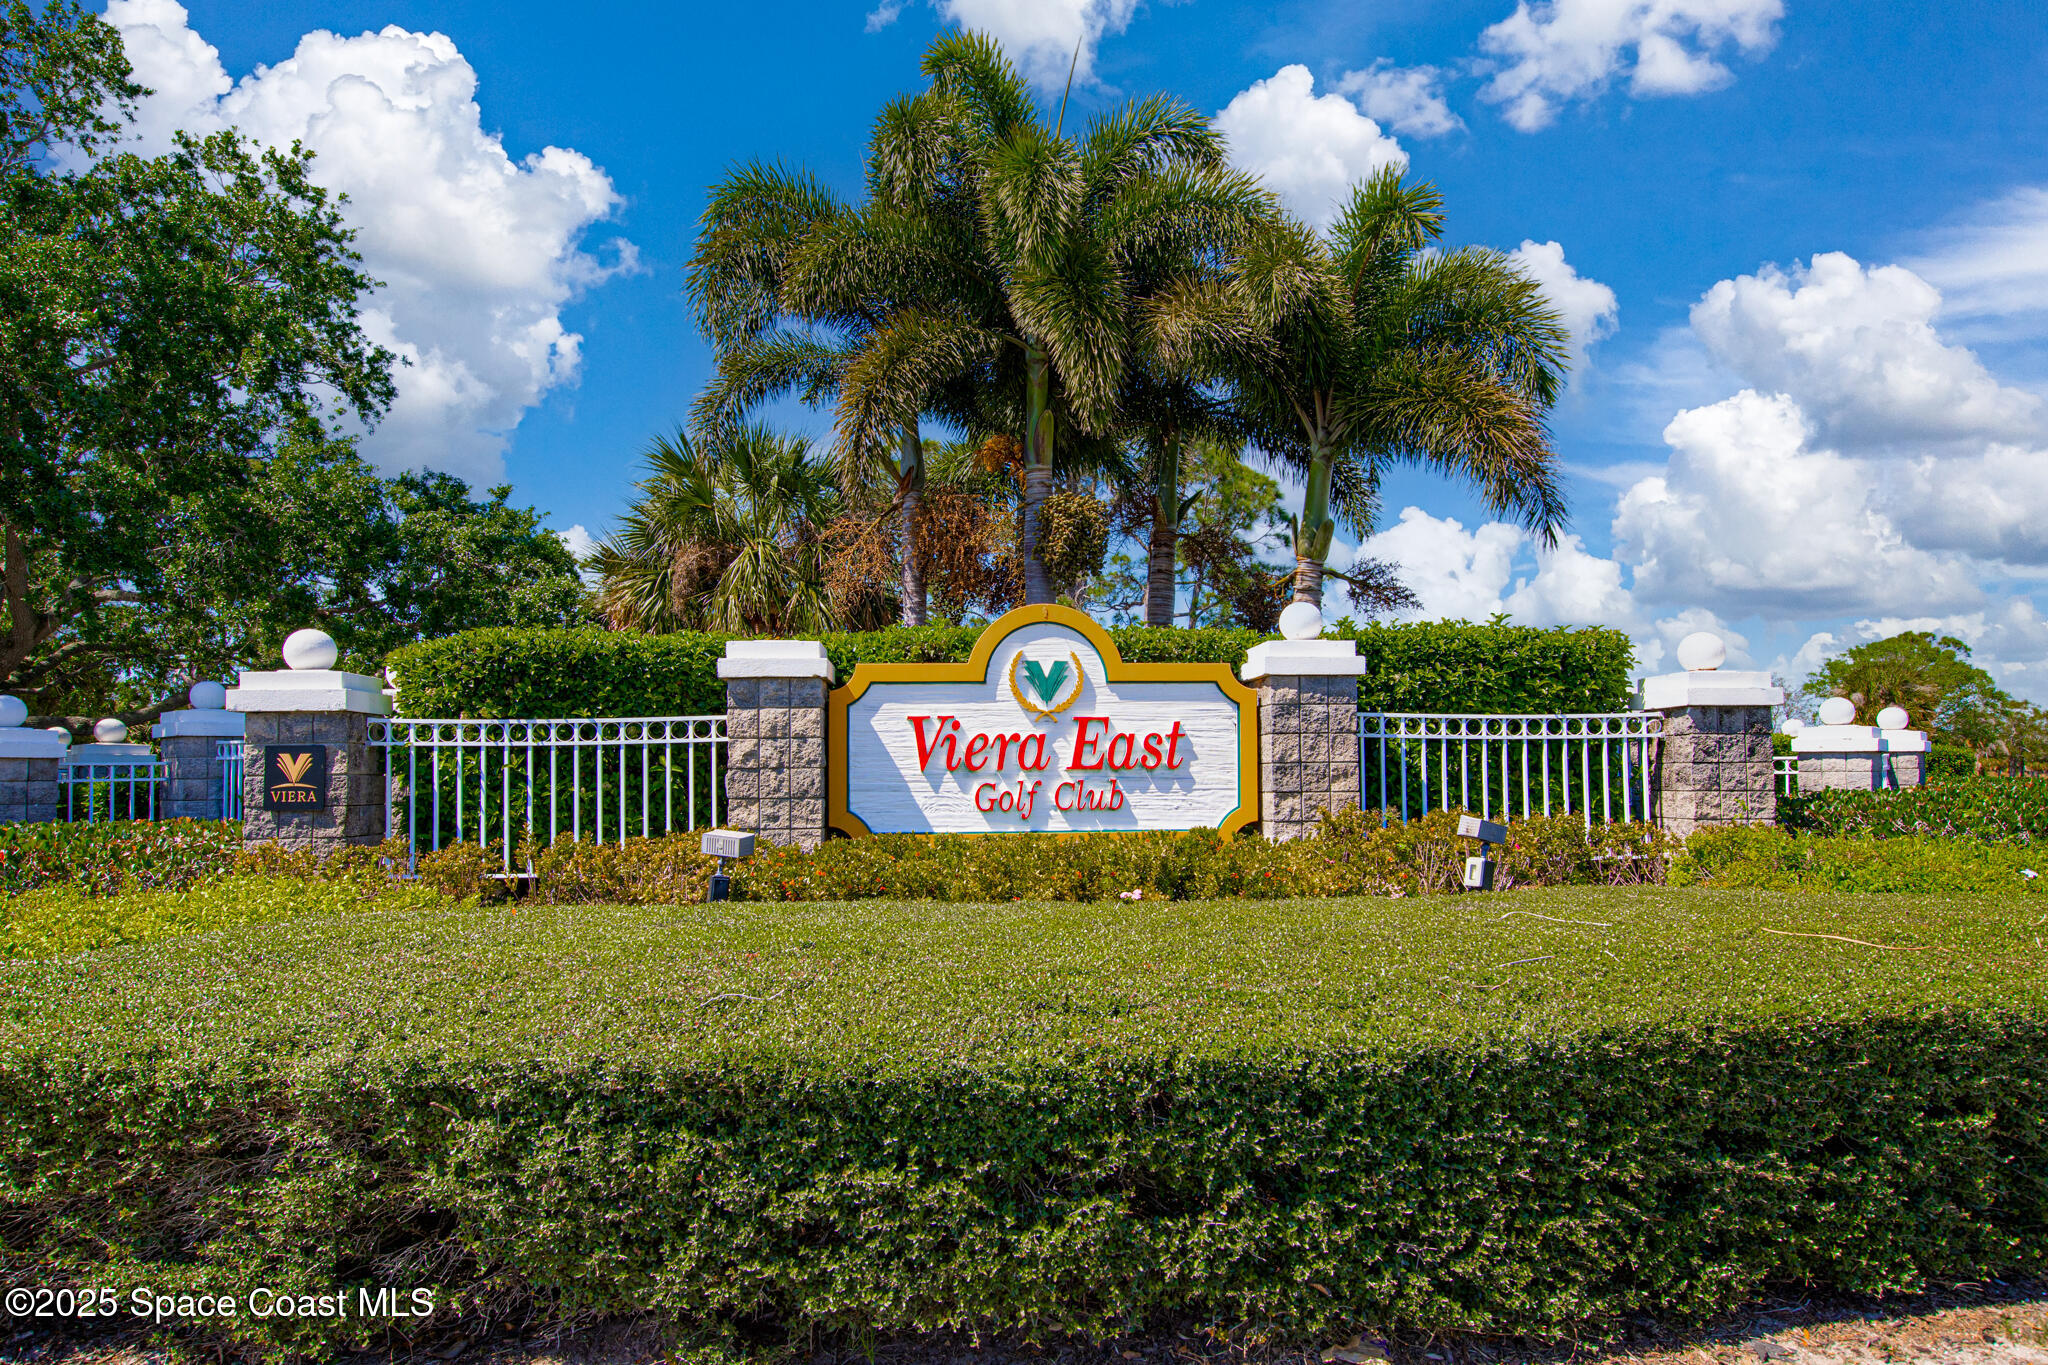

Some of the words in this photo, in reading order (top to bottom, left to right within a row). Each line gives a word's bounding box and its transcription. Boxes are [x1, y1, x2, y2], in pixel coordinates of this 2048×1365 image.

[907, 715, 1051, 773] Viera
[1066, 716, 1186, 771] East
[270, 790, 317, 803] VIERA
[974, 780, 1042, 819] Golf
[1054, 779, 1124, 811] Club
